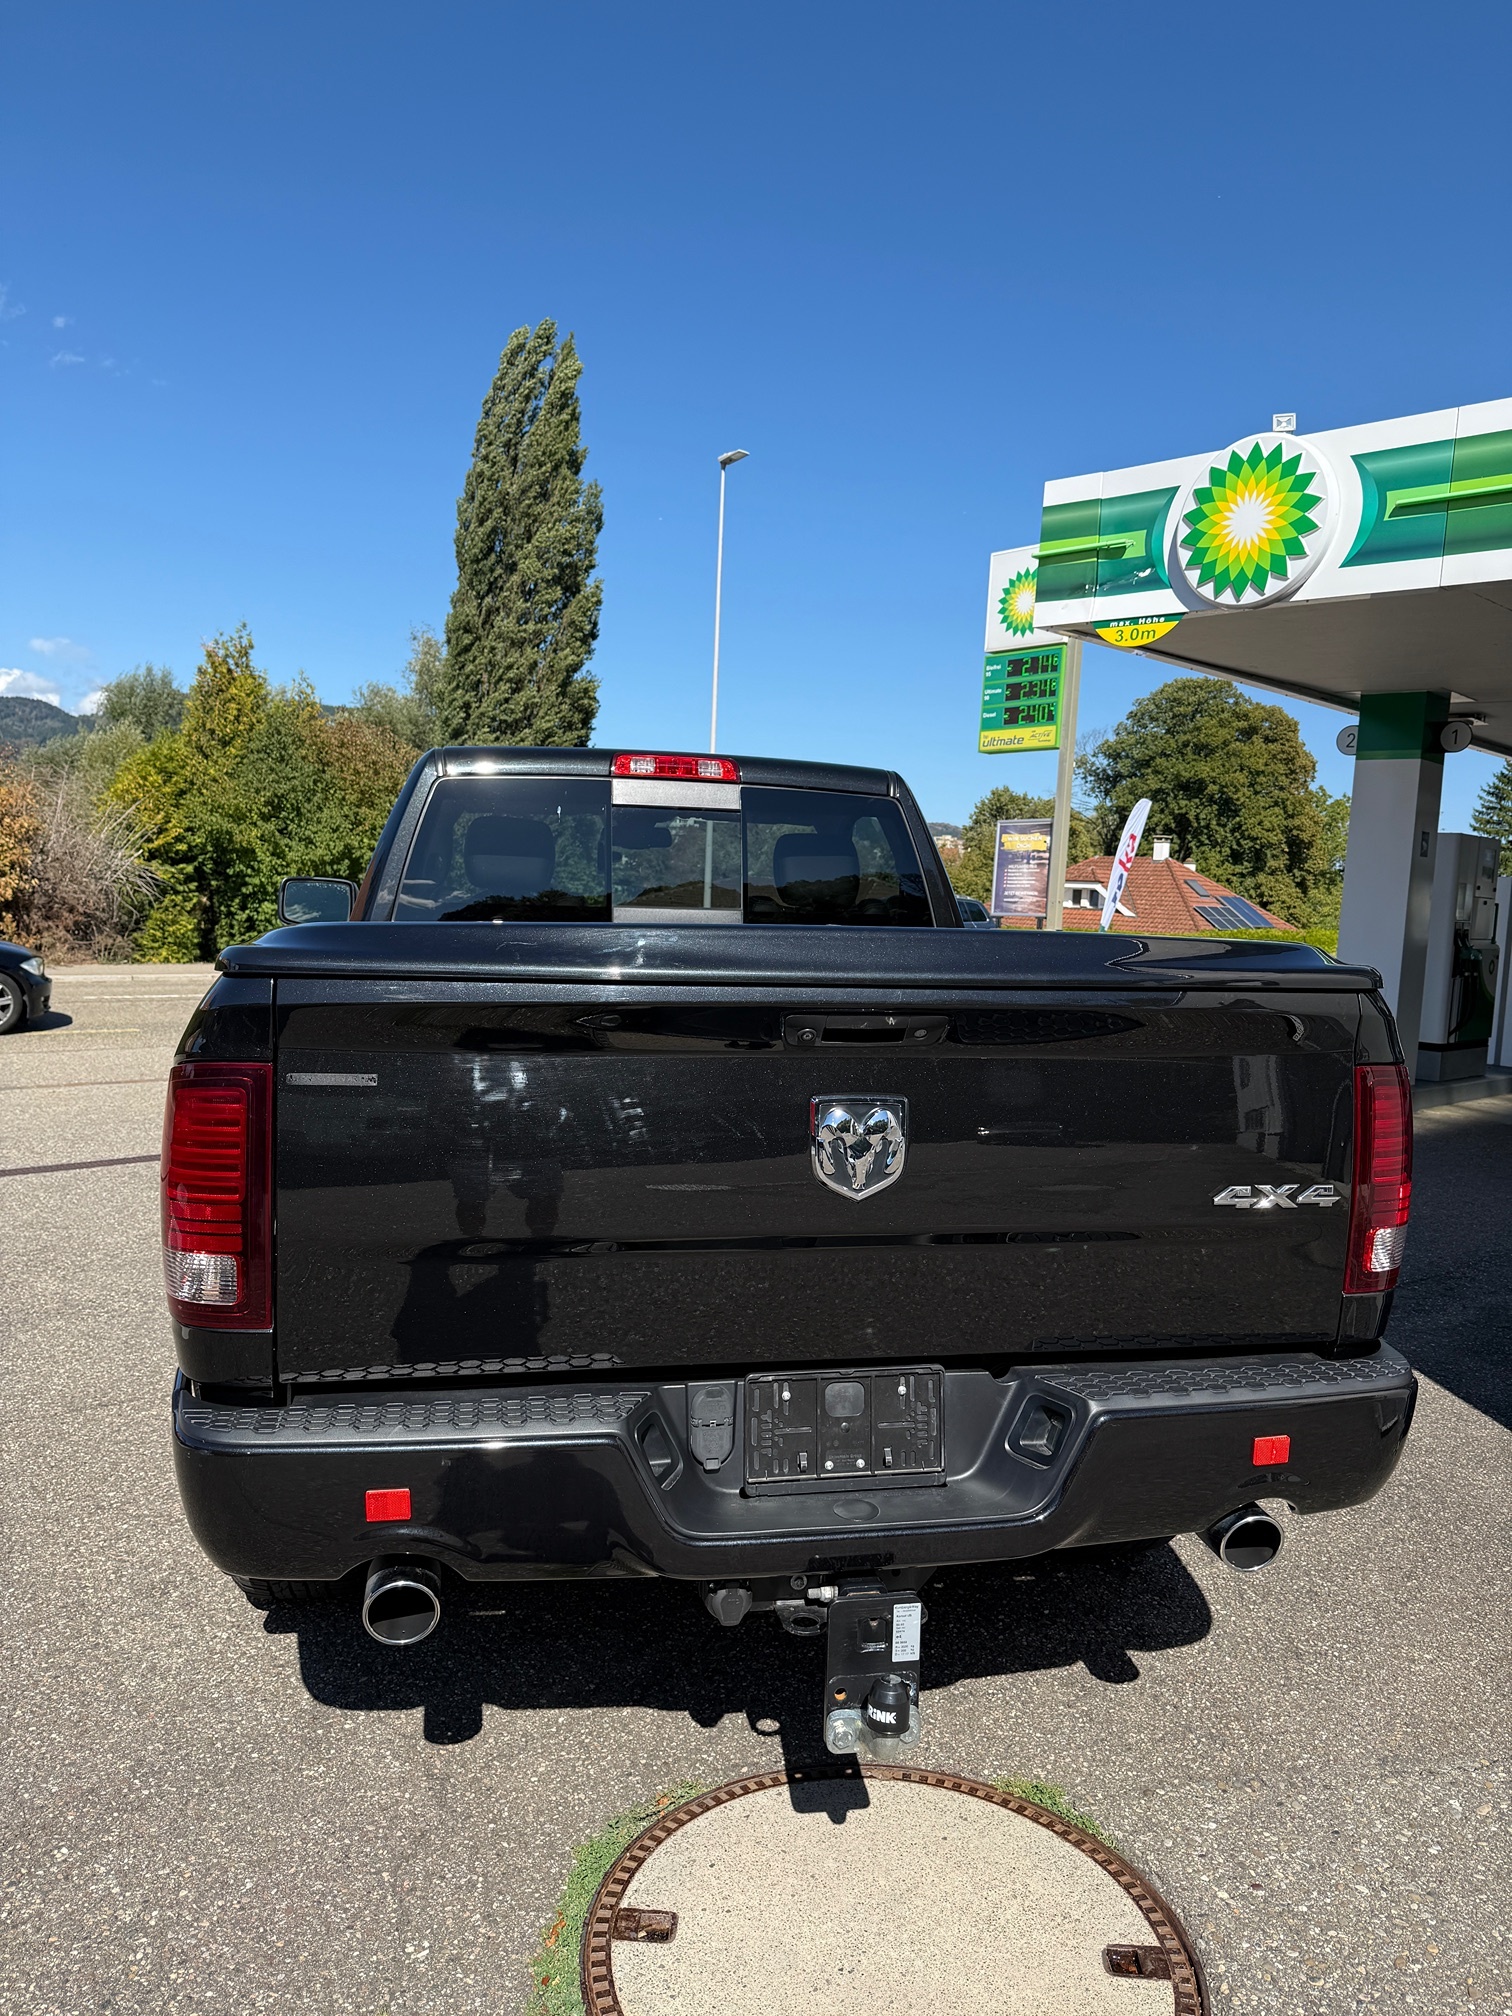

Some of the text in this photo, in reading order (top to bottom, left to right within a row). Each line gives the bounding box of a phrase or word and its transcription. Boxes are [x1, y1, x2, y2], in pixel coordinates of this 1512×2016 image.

[1109, 620, 1134, 628] max.
[1114, 628, 1156, 643] 3.0m
[982, 735, 1025, 748] ultimate
[1345, 732, 1356, 748] 2
[1451, 729, 1459, 745] 1
